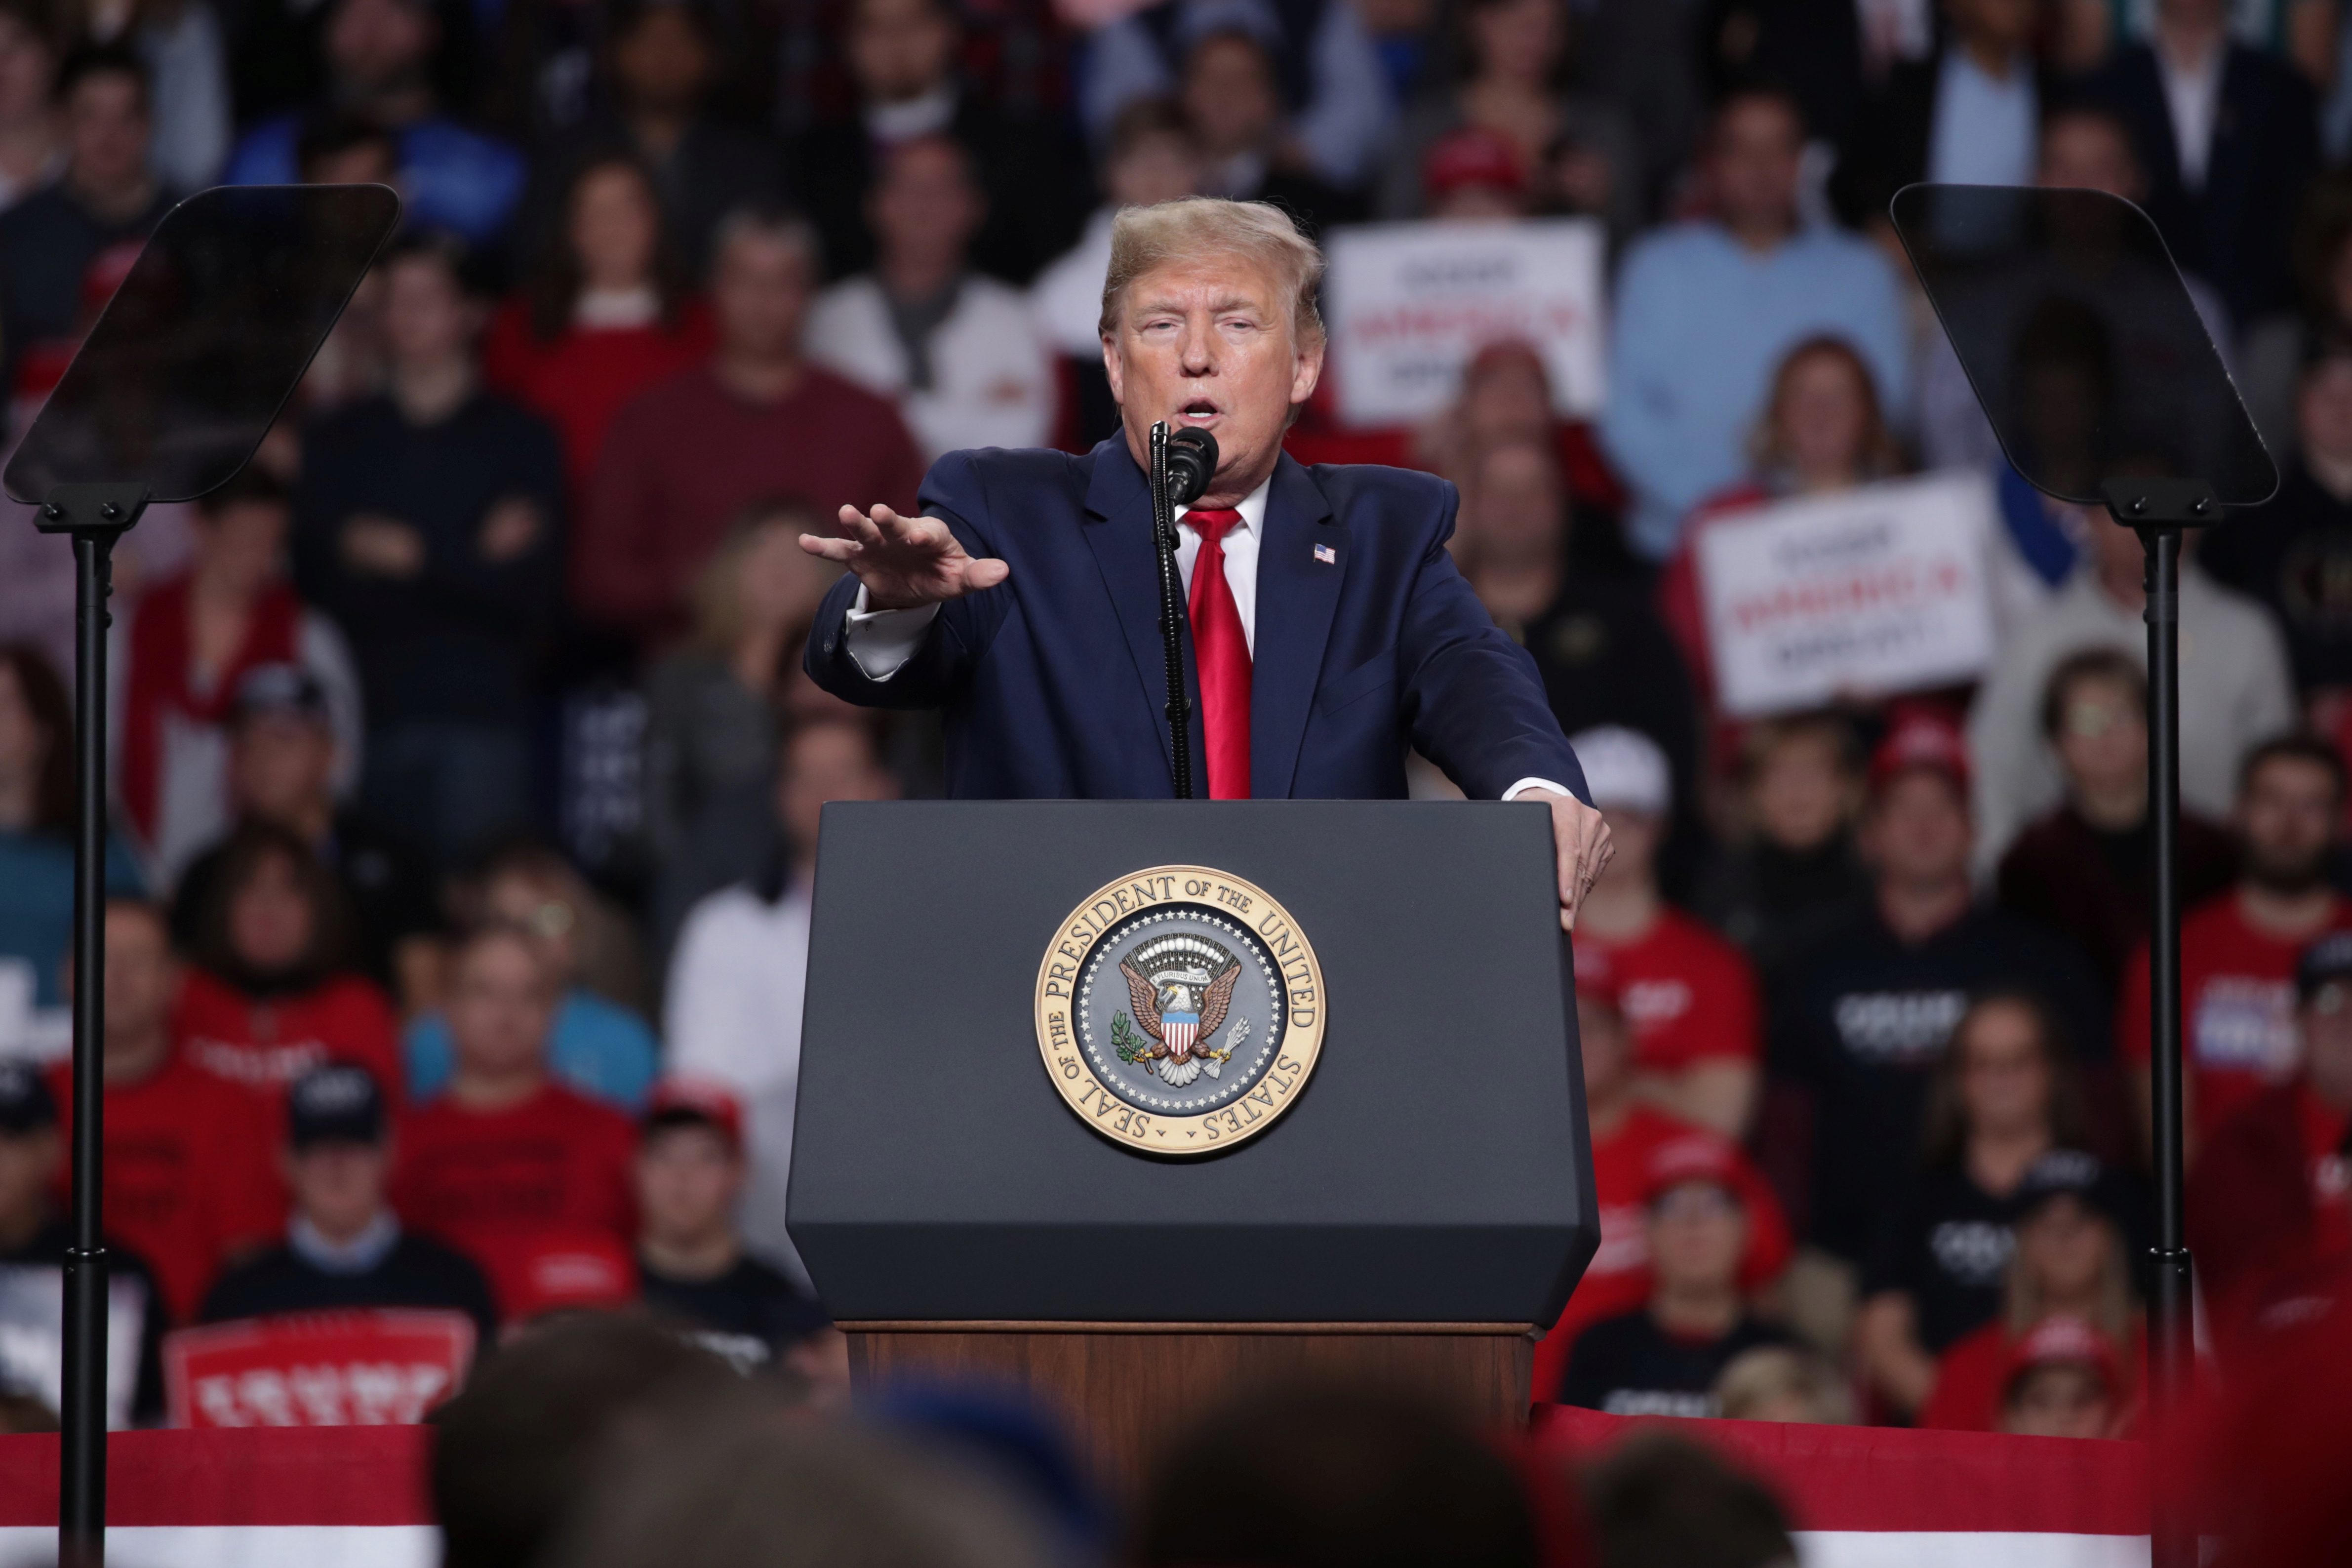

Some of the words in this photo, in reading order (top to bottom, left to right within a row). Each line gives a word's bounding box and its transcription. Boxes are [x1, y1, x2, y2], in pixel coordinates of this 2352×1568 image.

[1185, 879, 1212, 896] OF
[1218, 885, 1253, 914] THE
[1045, 875, 1176, 1000] PRESIDENT
[1258, 910, 1316, 1028] UNITED
[1048, 1011, 1069, 1050] THE
[1058, 1055, 1079, 1079] OF
[1079, 1078, 1150, 1138] SEAL
[1203, 1054, 1302, 1140] STATES
